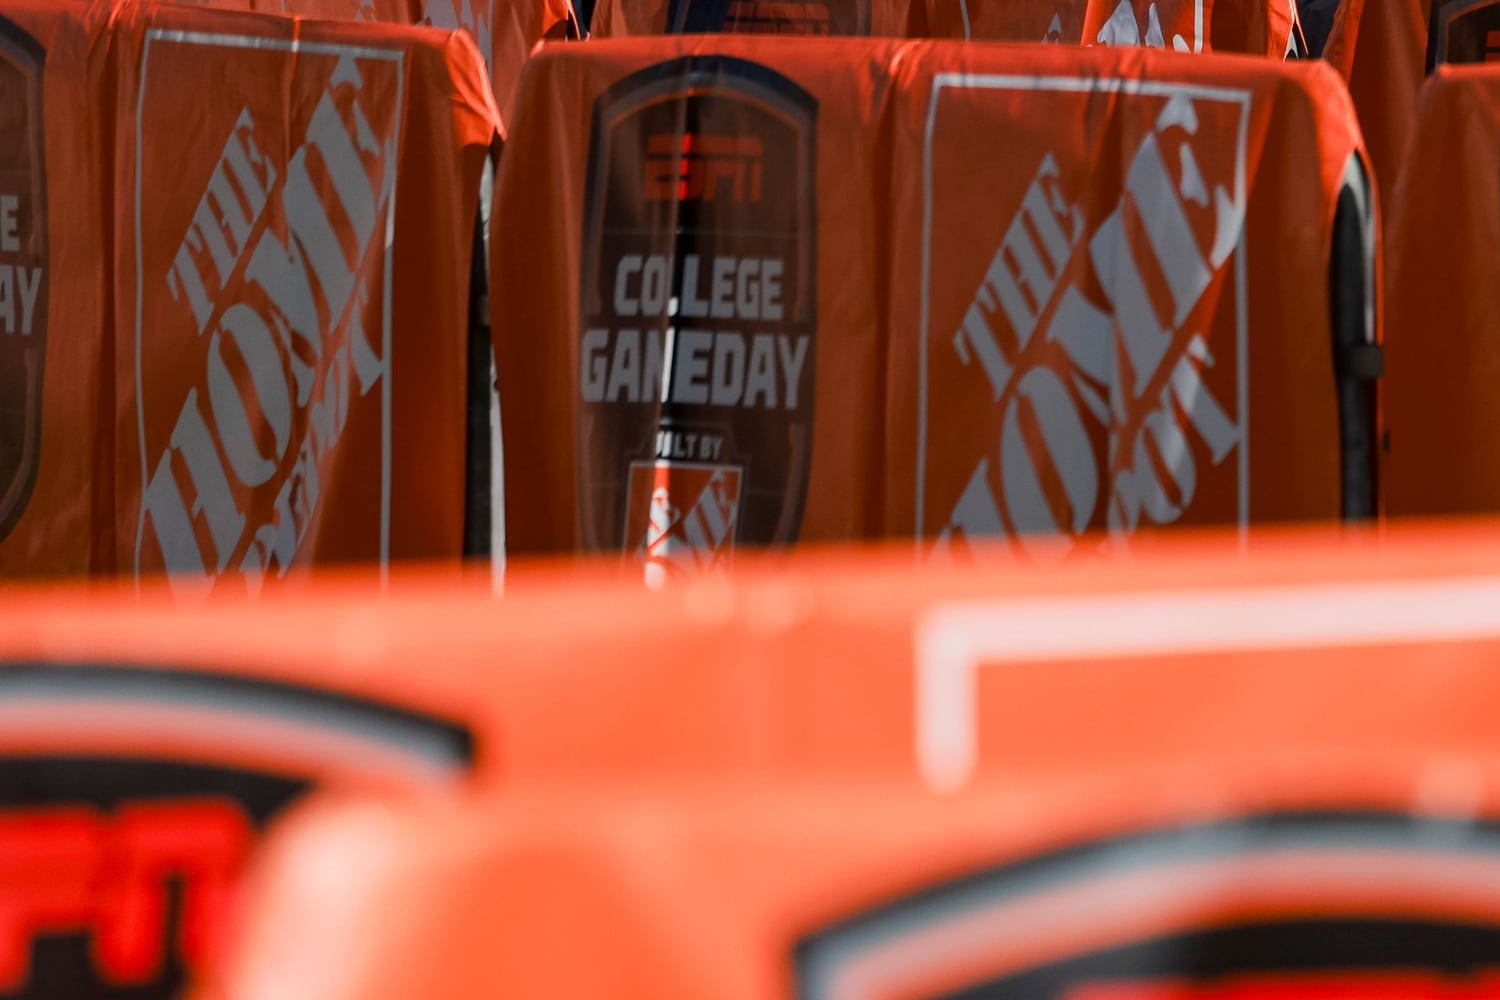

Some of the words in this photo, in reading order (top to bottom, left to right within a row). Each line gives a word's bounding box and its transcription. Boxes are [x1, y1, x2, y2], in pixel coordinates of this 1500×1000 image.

[166, 106, 277, 336] THE
[644, 133, 763, 201] ESPN
[953, 153, 1085, 400] THE
[145, 52, 396, 600] HOME
[580, 326, 809, 410] GAMEDAY
